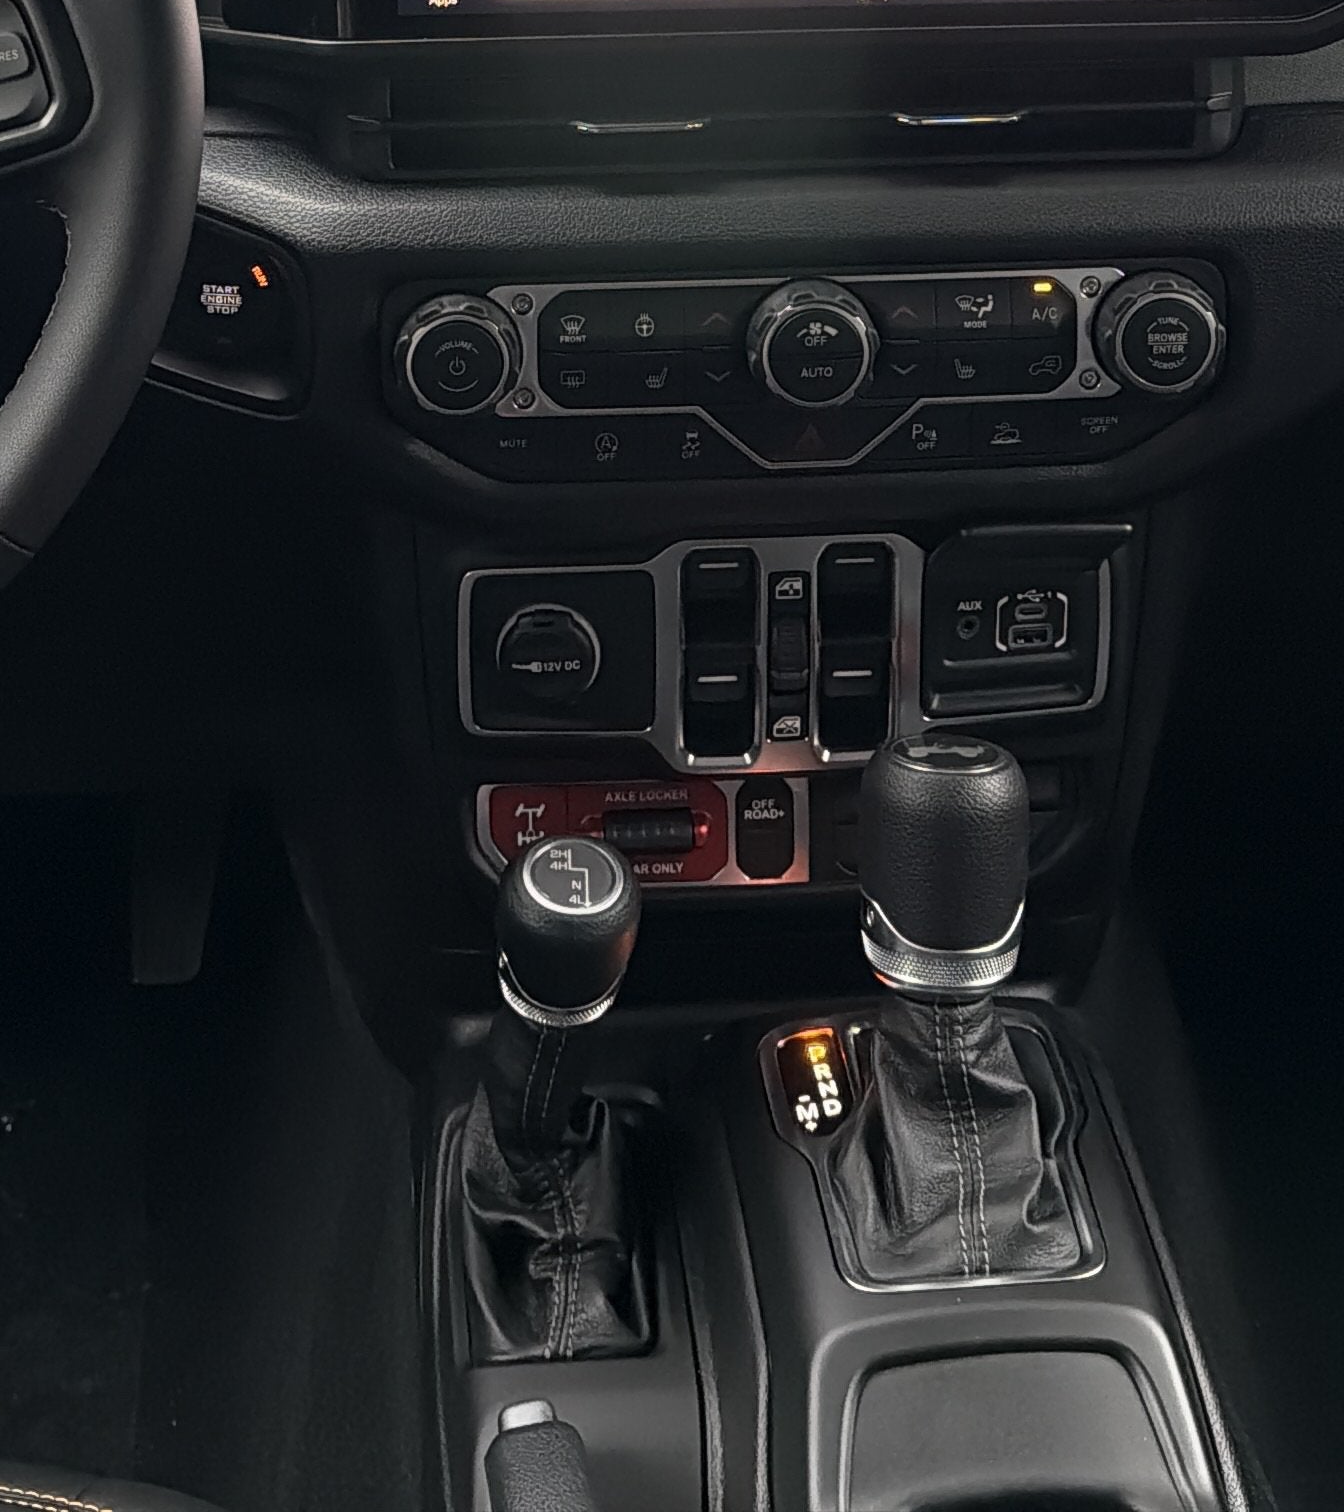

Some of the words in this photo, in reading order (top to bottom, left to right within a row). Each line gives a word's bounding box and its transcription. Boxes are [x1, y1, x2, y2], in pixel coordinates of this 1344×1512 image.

[202, 284, 240, 294] START
[200, 294, 243, 305] ENGINE
[206, 305, 238, 315] STOP
[1031, 308, 1057, 321] A/C
[963, 320, 988, 329] MODE
[1157, 316, 1181, 326] TUNE
[559, 334, 587, 344] FRONT
[804, 335, 828, 347] OFF
[1147, 332, 1189, 343] BROWSE
[1152, 344, 1185, 355] ENTER
[1151, 359, 1183, 370] SCROLL
[800, 367, 834, 378] AUTO
[1081, 416, 1119, 426] SCREEN
[1089, 426, 1108, 435] OFF
[499, 439, 528, 449] MUTE
[916, 441, 937, 451] OFF
[597, 451, 617, 462] OFF
[681, 449, 701, 460] OFF
[956, 600, 983, 611] AUX
[541, 661, 562, 673] 12V
[564, 660, 581, 671] DC
[605, 791, 638, 803] AXLE
[639, 789, 689, 801] LOCKER
[751, 799, 775, 809] OFF
[743, 808, 786, 820] ROAD+
[549, 848, 568, 859] 2H
[549, 860, 568, 870] 4H
[808, 1044, 826, 1064] P
[813, 1063, 833, 1081] R
[817, 1078, 839, 1098] N
[795, 1102, 820, 1122] M
[822, 1098, 842, 1117] D
